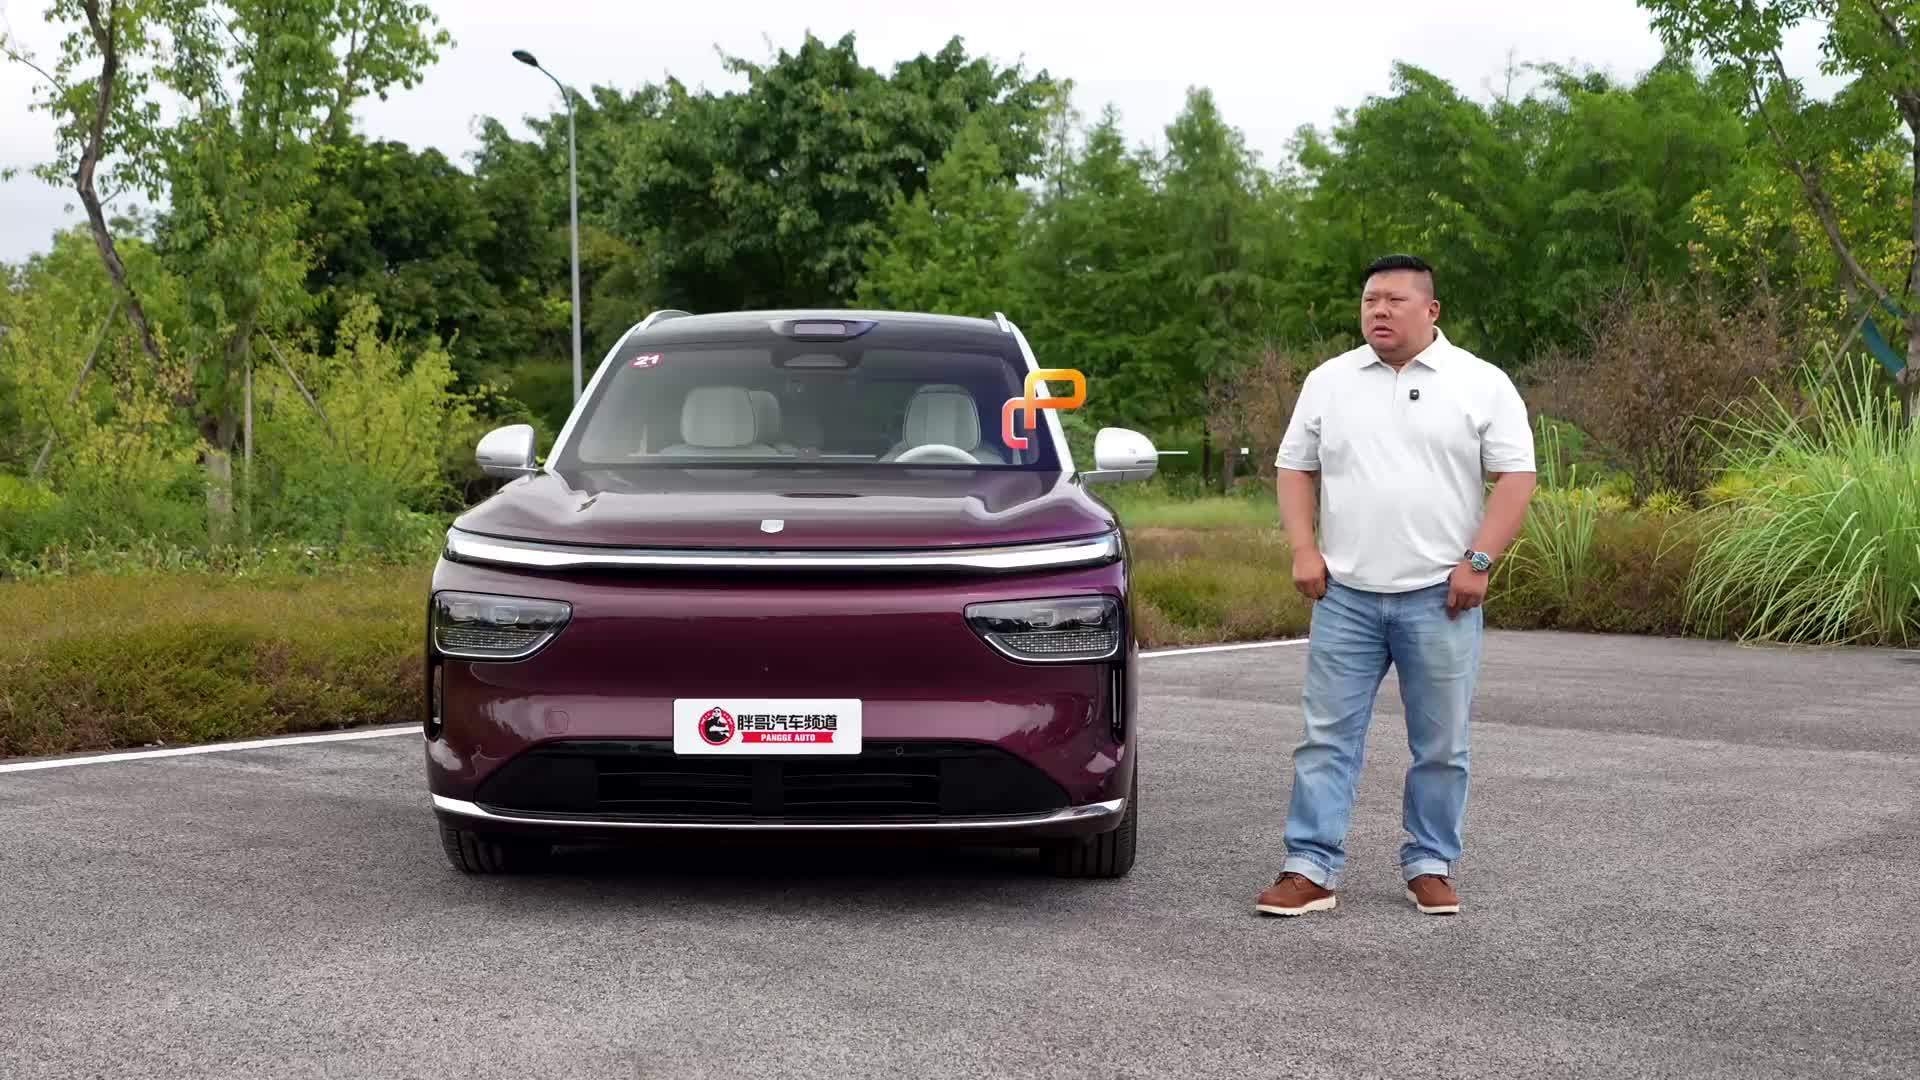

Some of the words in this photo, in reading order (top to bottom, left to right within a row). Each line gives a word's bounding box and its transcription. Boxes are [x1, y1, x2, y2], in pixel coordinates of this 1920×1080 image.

[633, 354, 660, 366] 21
[737, 714, 838, 731] 胖哥汽车频道
[760, 733, 793, 742] PANGGE
[794, 733, 816, 742] AUTO
